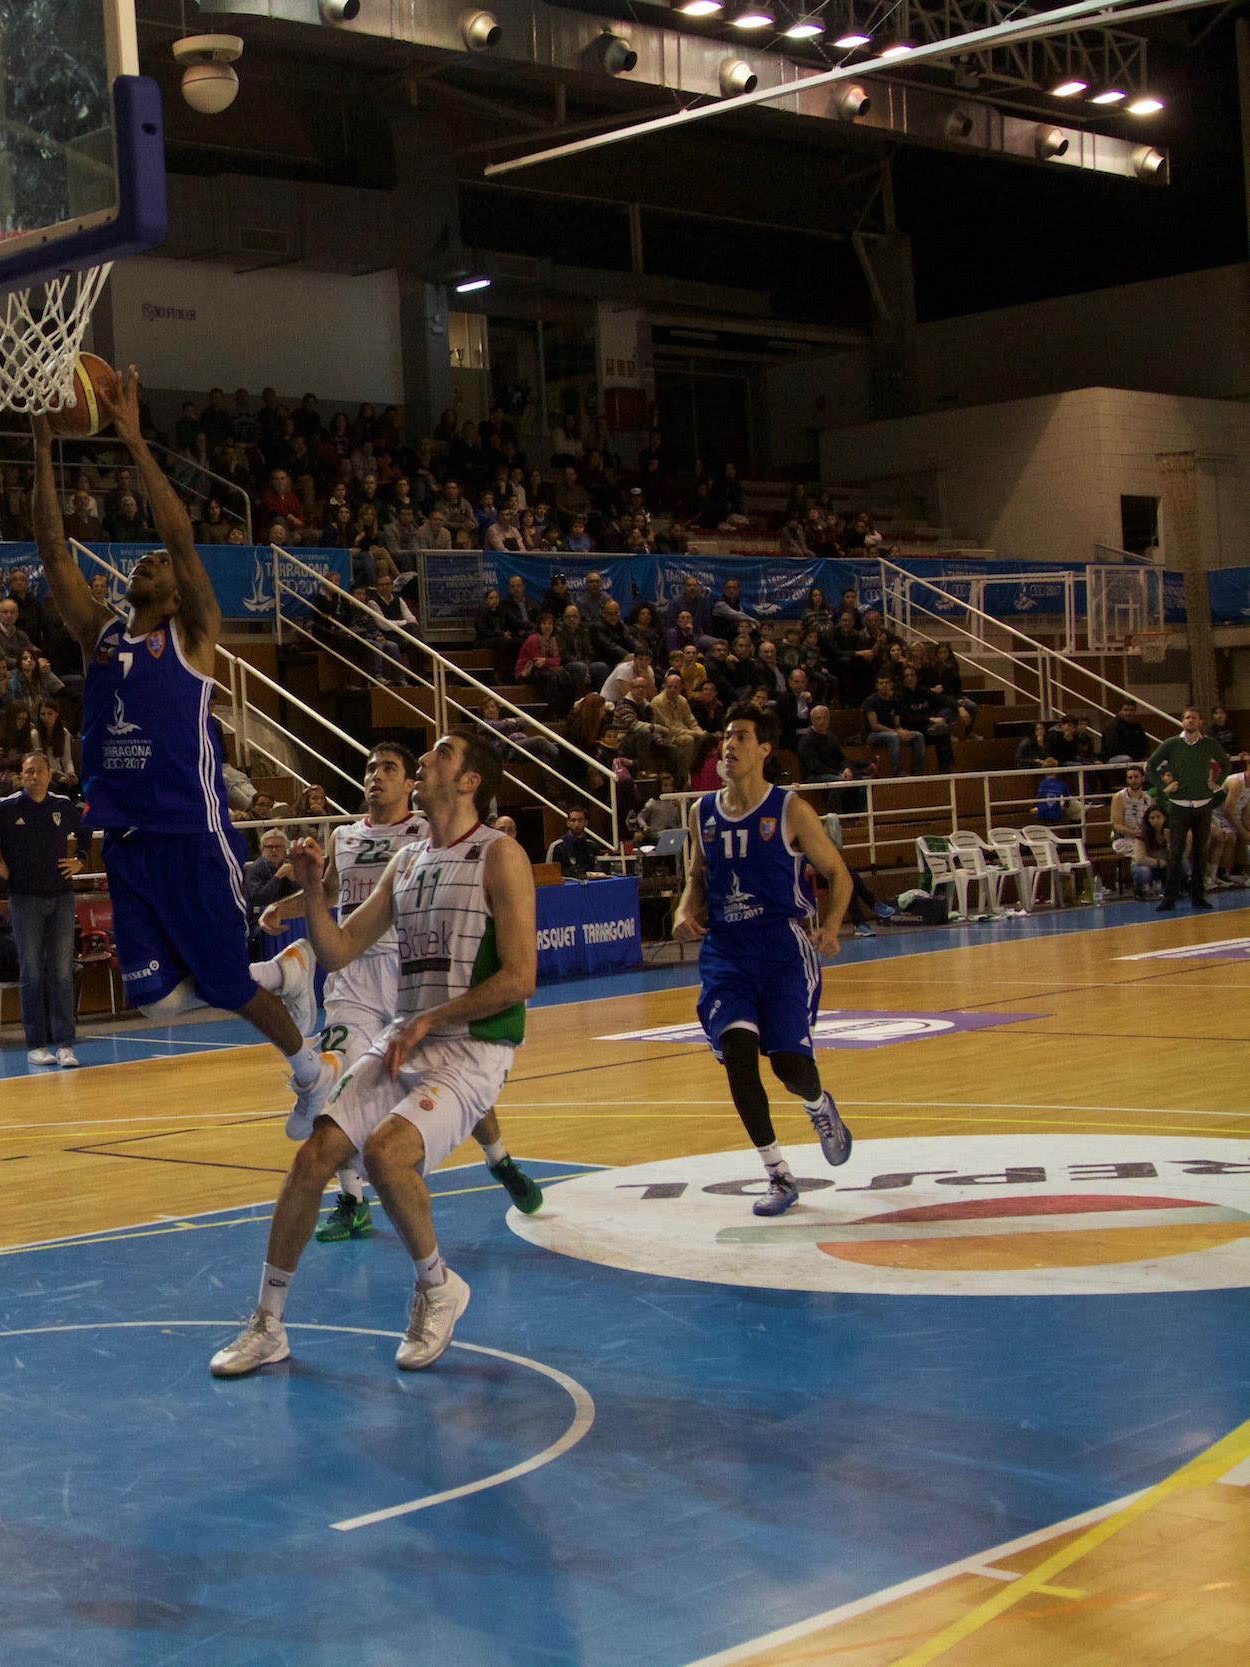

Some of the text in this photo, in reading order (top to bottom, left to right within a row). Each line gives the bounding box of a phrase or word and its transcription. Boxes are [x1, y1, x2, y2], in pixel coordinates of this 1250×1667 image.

[118, 651, 134, 680] 7
[354, 839, 391, 865] 22
[720, 828, 749, 860] 11
[340, 876, 376, 904] Bitt
[416, 867, 442, 908] 11
[536, 924, 576, 952] ASQUET
